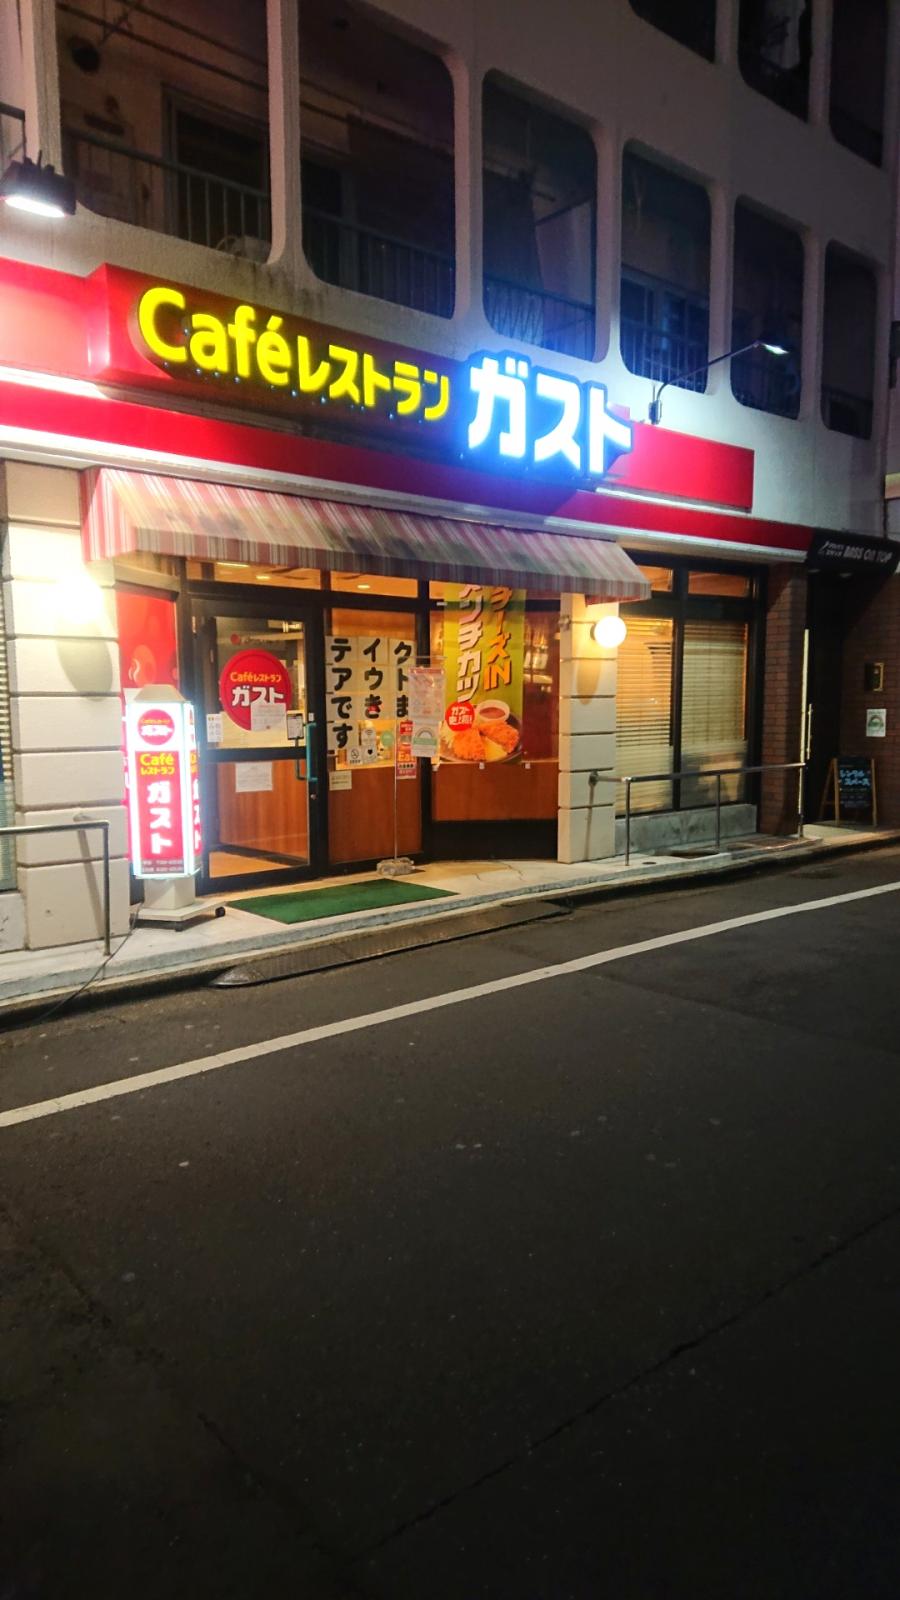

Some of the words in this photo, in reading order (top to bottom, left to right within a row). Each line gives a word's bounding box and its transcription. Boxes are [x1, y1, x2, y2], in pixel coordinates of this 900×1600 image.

[467, 355, 633, 475] ガスト
[231, 685, 286, 707] ガスト
[332, 722, 354, 749] す
[139, 752, 175, 767] Café
[147, 780, 173, 855] ガスト
